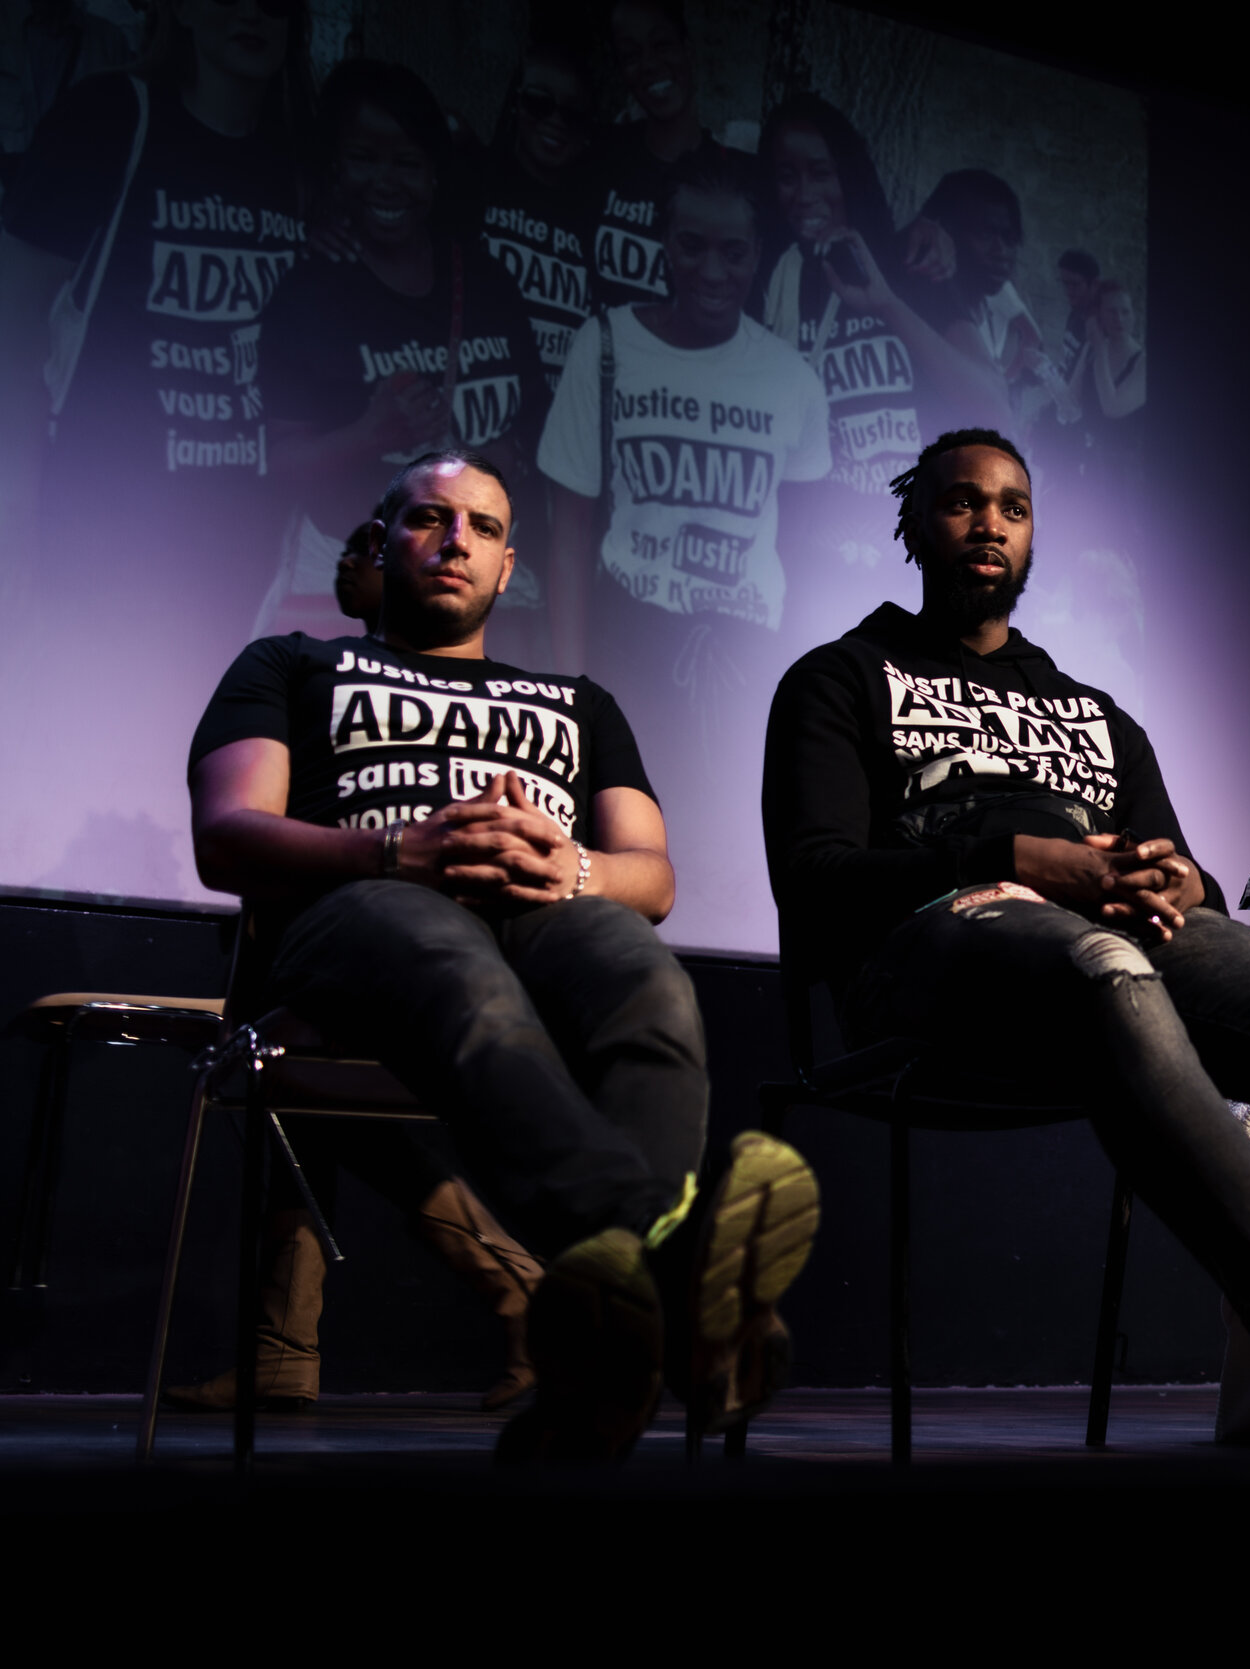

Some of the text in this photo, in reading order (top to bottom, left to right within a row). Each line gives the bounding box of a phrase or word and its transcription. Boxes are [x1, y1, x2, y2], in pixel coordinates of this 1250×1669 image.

[152, 189, 307, 244] Justice pour
[484, 205, 549, 244] ustice
[604, 189, 656, 226] Justi
[152, 250, 287, 312] ADAM
[499, 244, 591, 312] DAM
[598, 231, 670, 291] ADA
[151, 339, 231, 375] sans
[359, 339, 449, 384] Justice
[457, 335, 512, 375] pour
[158, 389, 233, 421] vous
[710, 400, 774, 435] pour
[166, 429, 258, 472] jamais
[620, 439, 771, 512] ADAMA
[673, 523, 748, 575] justi
[335, 650, 577, 706] Justice pour
[882, 659, 1105, 720] JUSTICE POUR
[335, 690, 578, 778] ADAMA
[891, 730, 961, 749] SANS
[336, 760, 576, 827] sans juice
